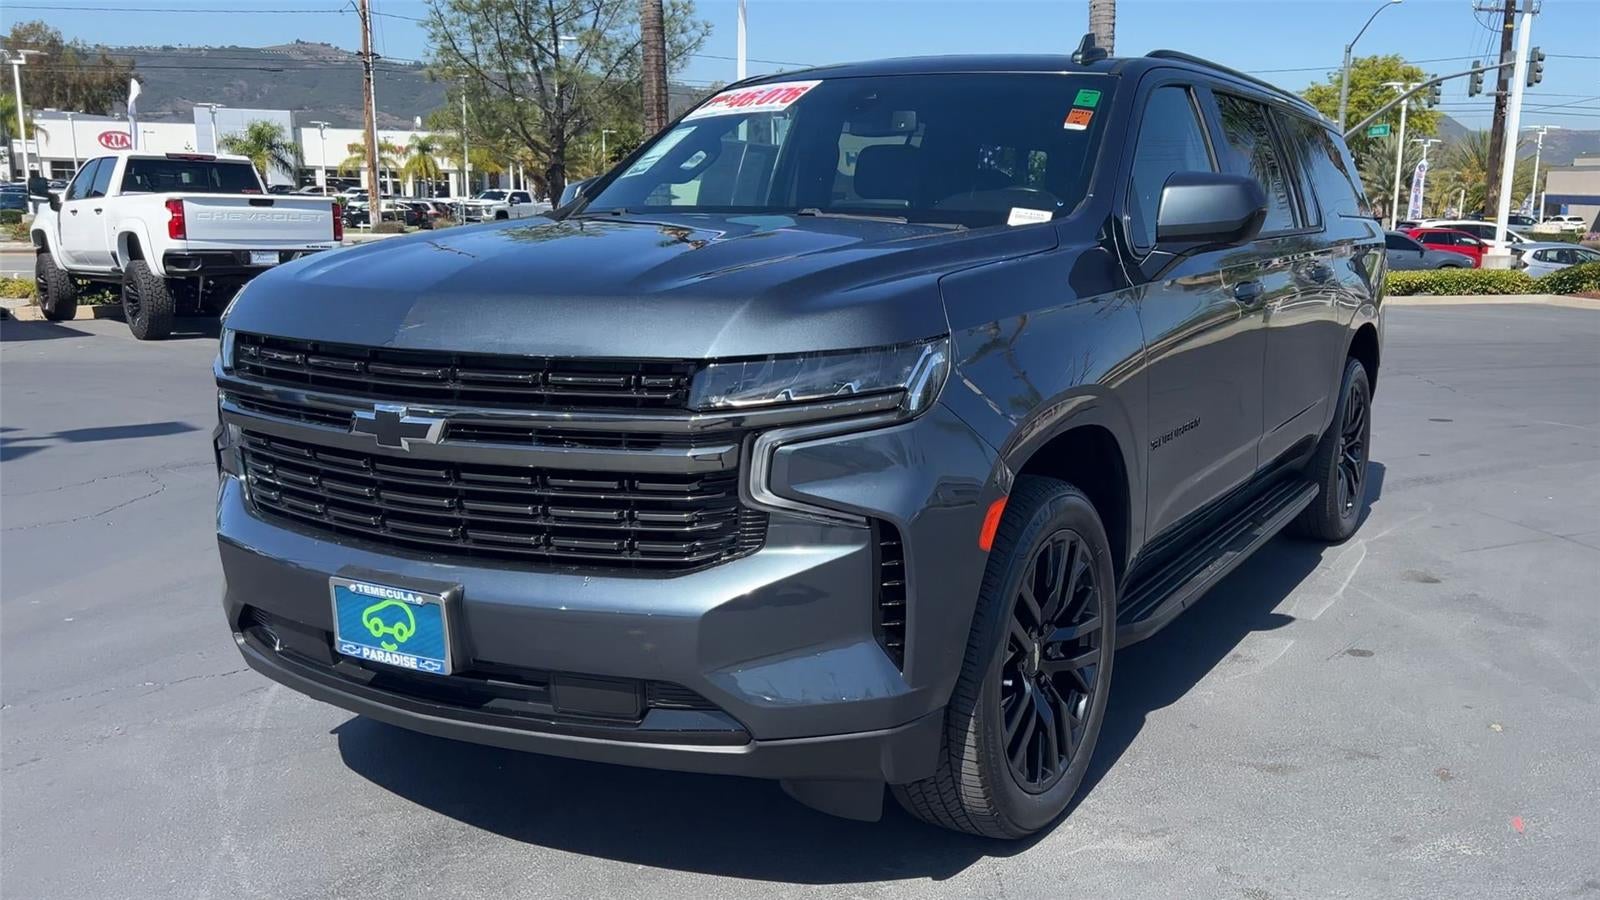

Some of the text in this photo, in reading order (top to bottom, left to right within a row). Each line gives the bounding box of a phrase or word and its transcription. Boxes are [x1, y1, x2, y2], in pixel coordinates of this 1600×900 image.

[104, 134, 128, 147] KIA
[196, 211, 325, 223] CHEVROLET
[1150, 416, 1201, 450] SUBURBAN
[356, 583, 415, 602] TEMECULA
[362, 647, 418, 669] PARADISE
